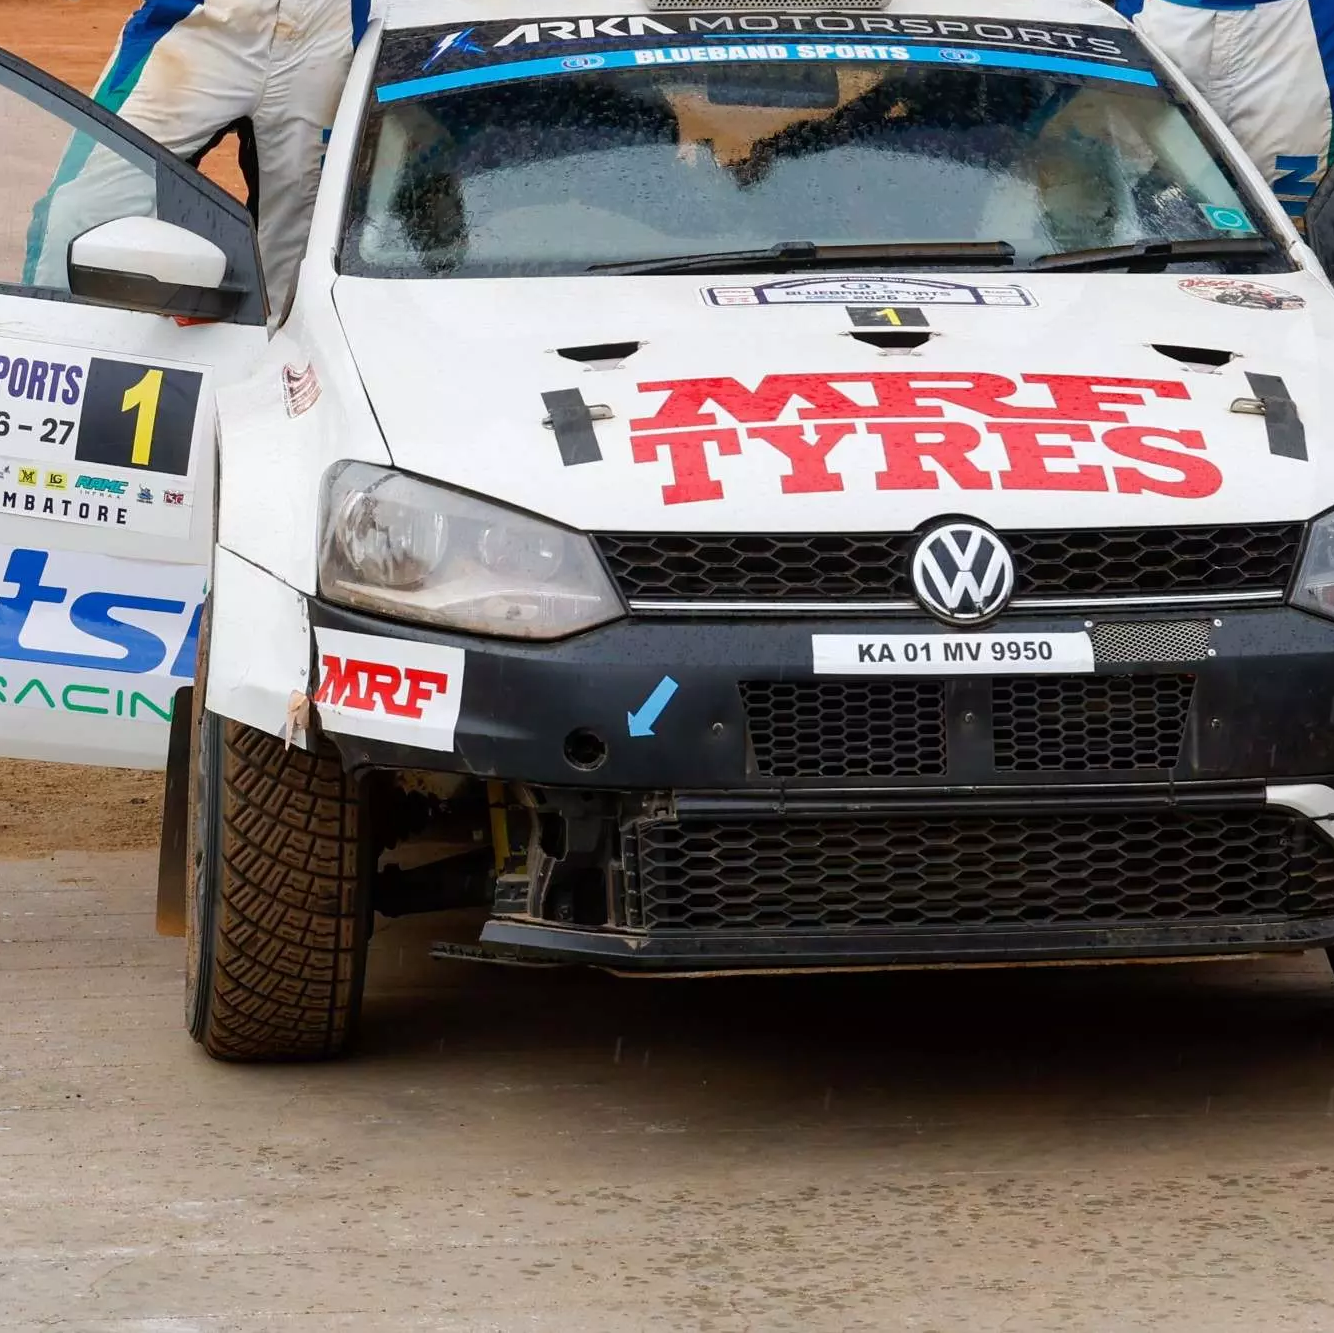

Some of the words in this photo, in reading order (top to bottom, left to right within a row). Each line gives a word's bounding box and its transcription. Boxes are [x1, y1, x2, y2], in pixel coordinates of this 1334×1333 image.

[494, 16, 678, 48] ARKA
[688, 12, 1123, 57] MOTORSPORTS
[635, 45, 789, 65] BLUEBAND
[797, 45, 911, 63] SPORTS
[121, 369, 164, 466] 1
[630, 372, 1192, 433] MRF
[40, 418, 75, 446] 27
[631, 420, 1222, 506] TYRES
[858, 643, 896, 663] KA
[904, 642, 932, 662] 01
[943, 641, 982, 662] MV
[991, 641, 1053, 662] 9950
[315, 658, 448, 719] MRF
